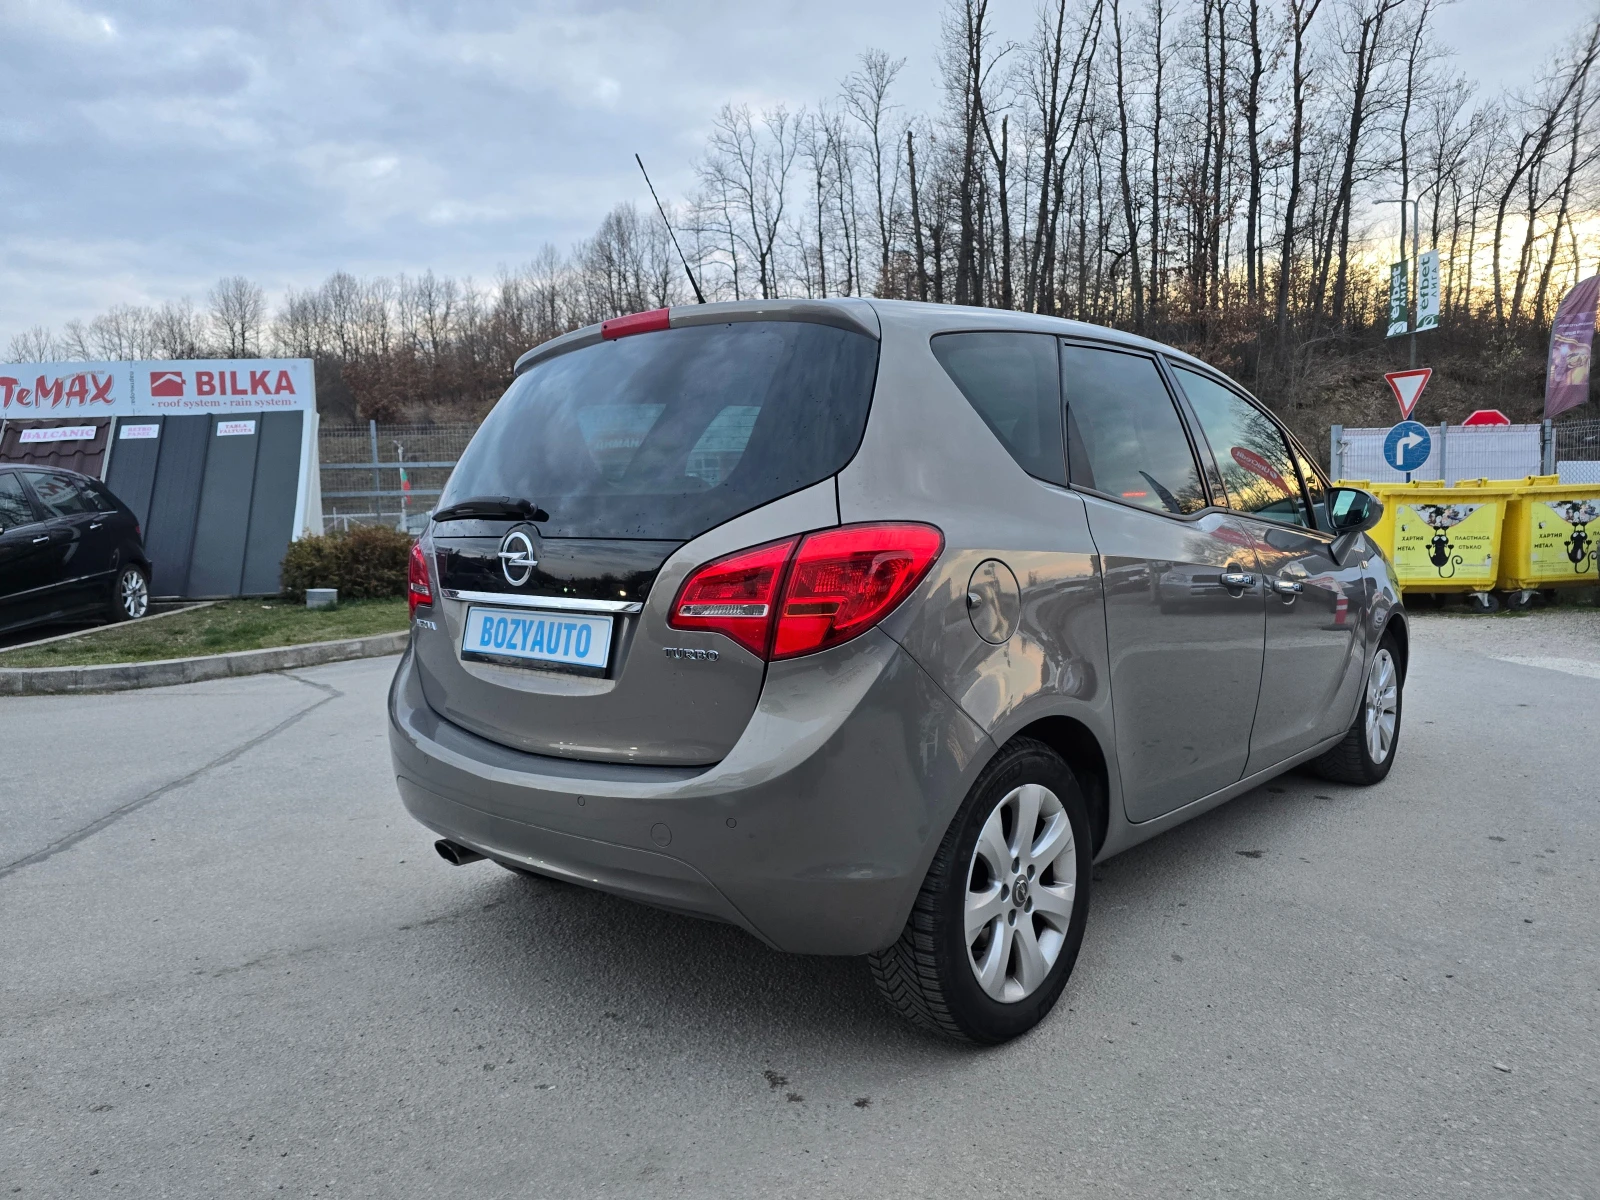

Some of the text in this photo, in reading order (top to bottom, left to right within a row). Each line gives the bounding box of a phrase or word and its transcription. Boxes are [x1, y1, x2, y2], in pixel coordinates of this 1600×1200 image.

[1390, 265, 1401, 320] efbet
[1417, 256, 1430, 310] efbet
[195, 370, 296, 396] BILKA
[157, 398, 292, 409] roof system rain system
[22, 428, 95, 440] BALCANIC
[479, 616, 592, 659] BOZYAUTO
[663, 647, 719, 662] TURBO
